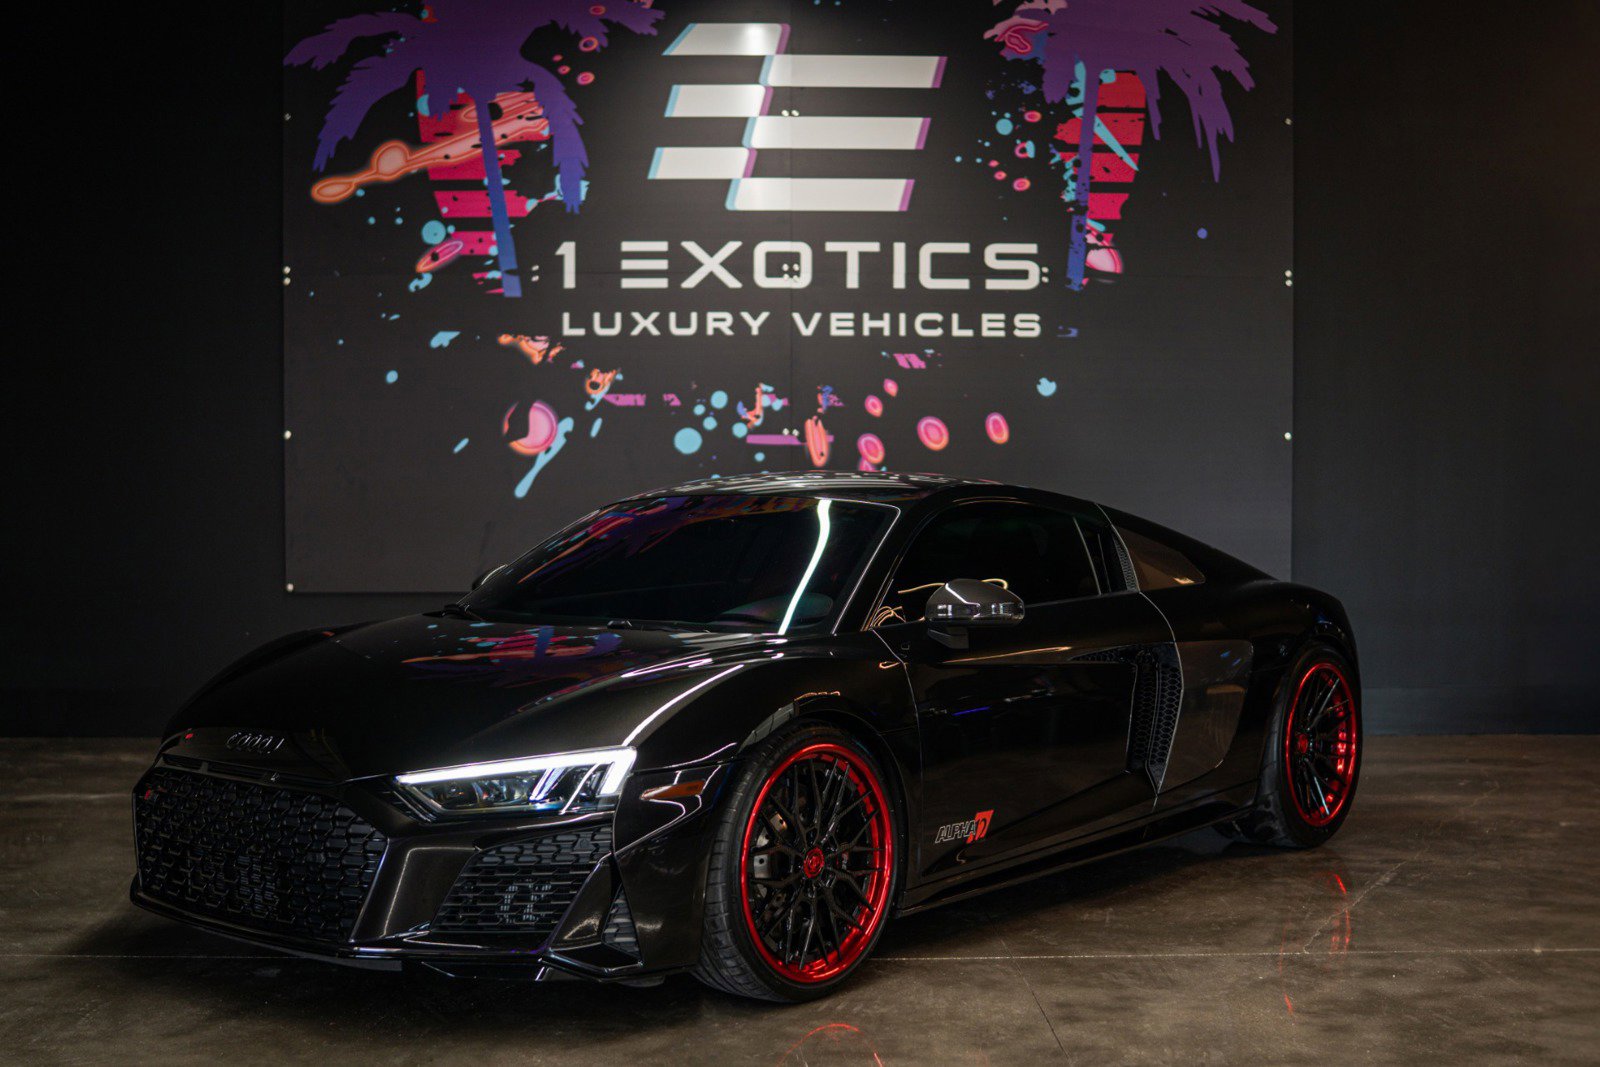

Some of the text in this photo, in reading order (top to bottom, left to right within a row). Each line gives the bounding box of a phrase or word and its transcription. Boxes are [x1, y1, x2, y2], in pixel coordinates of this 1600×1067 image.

[555, 241, 1041, 290] 1 EXOTICS
[562, 312, 1042, 338] LUXURY VEHICLES
